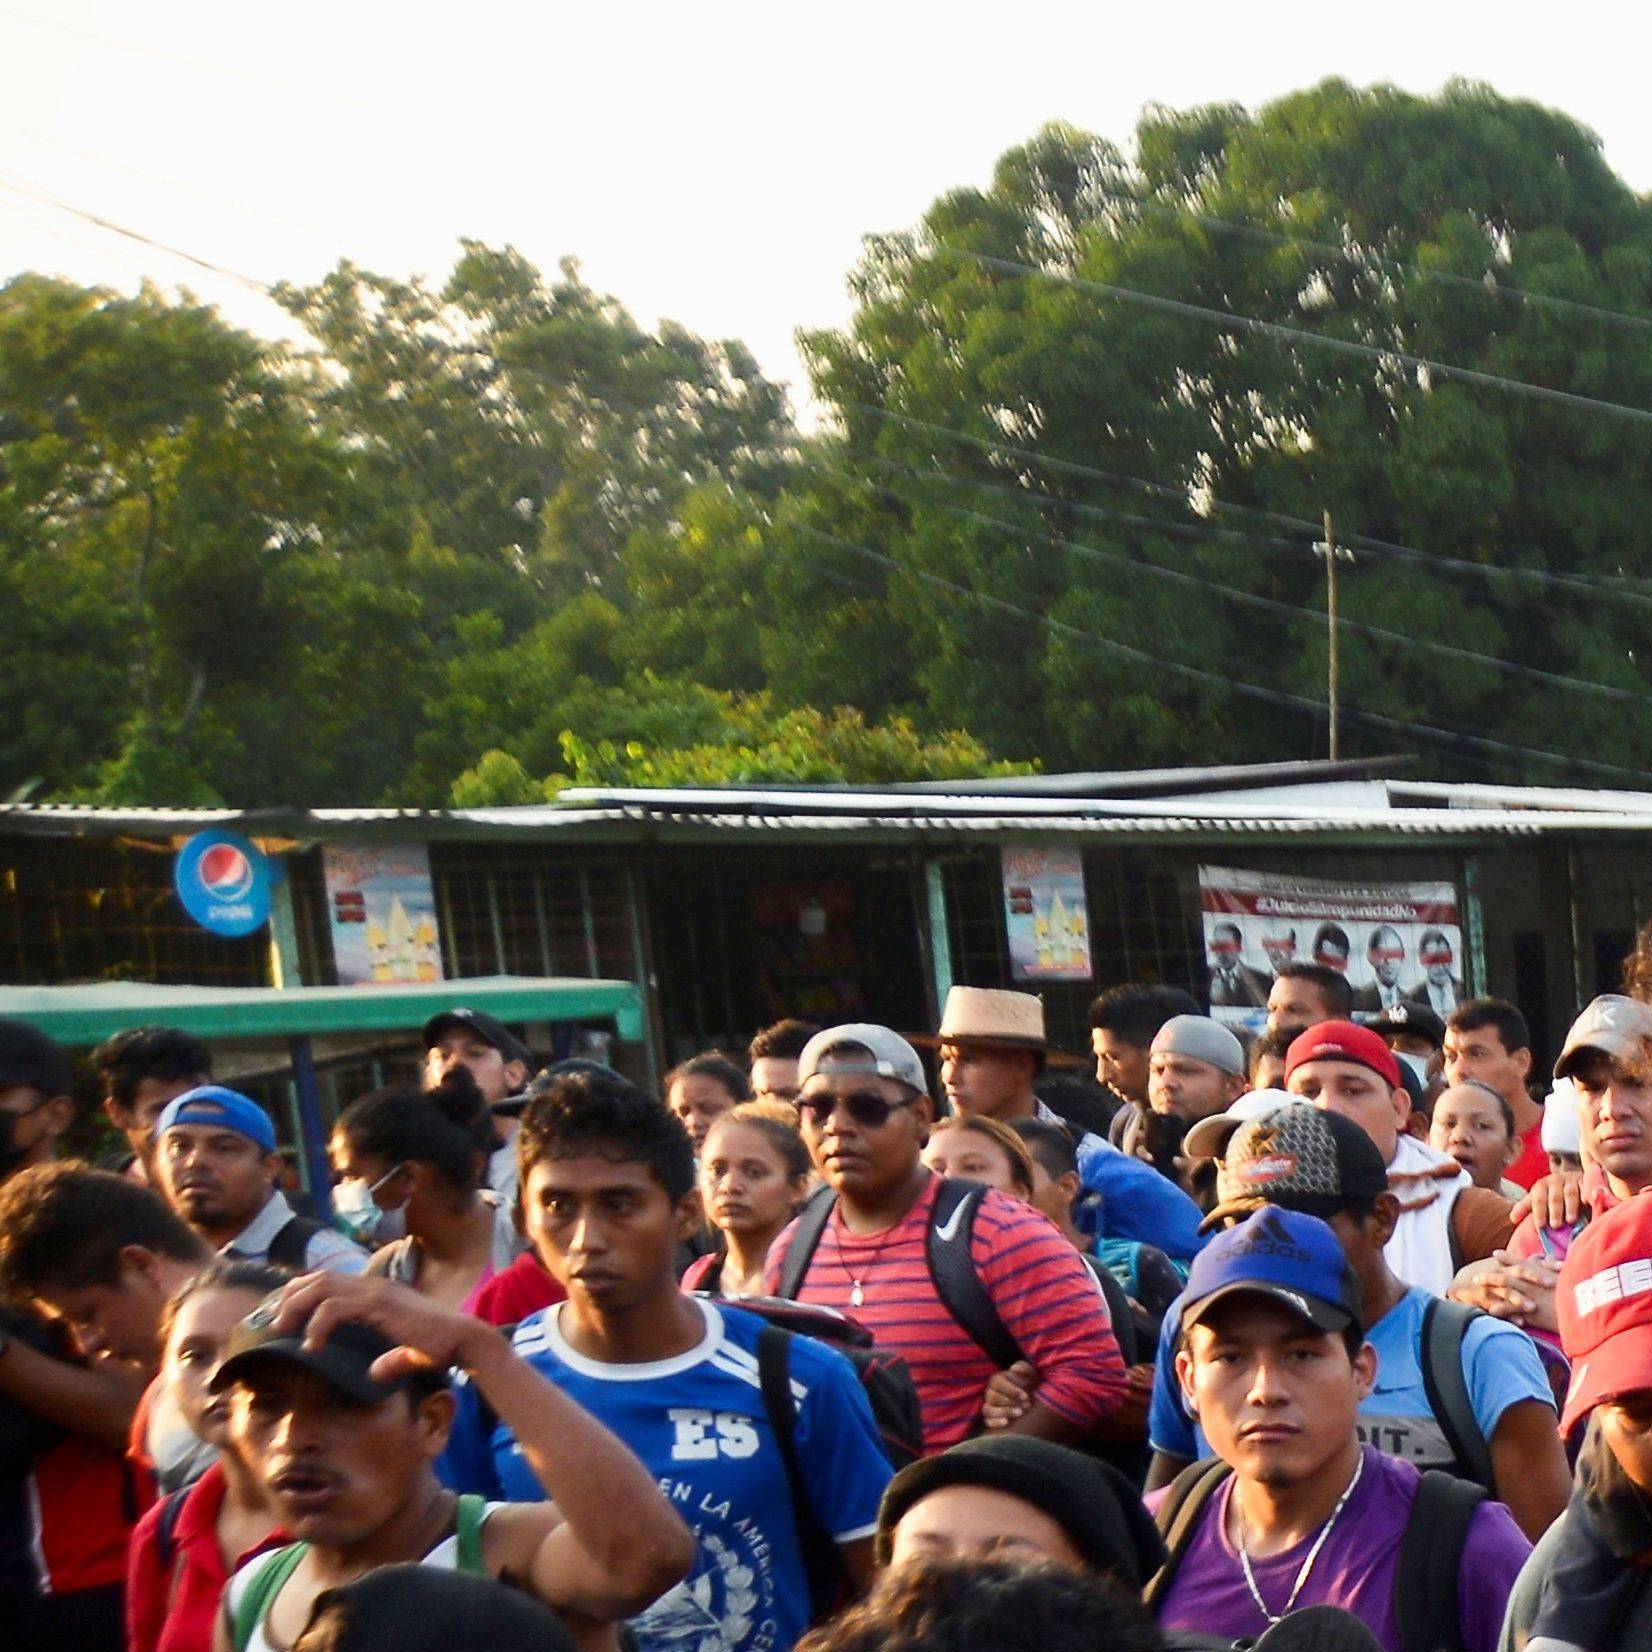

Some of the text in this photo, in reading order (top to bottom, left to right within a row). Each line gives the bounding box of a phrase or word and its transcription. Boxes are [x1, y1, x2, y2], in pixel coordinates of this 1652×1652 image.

[1216, 1238, 1313, 1262] adidas
[669, 1408, 760, 1460] ES
[700, 1493, 731, 1519] LA
